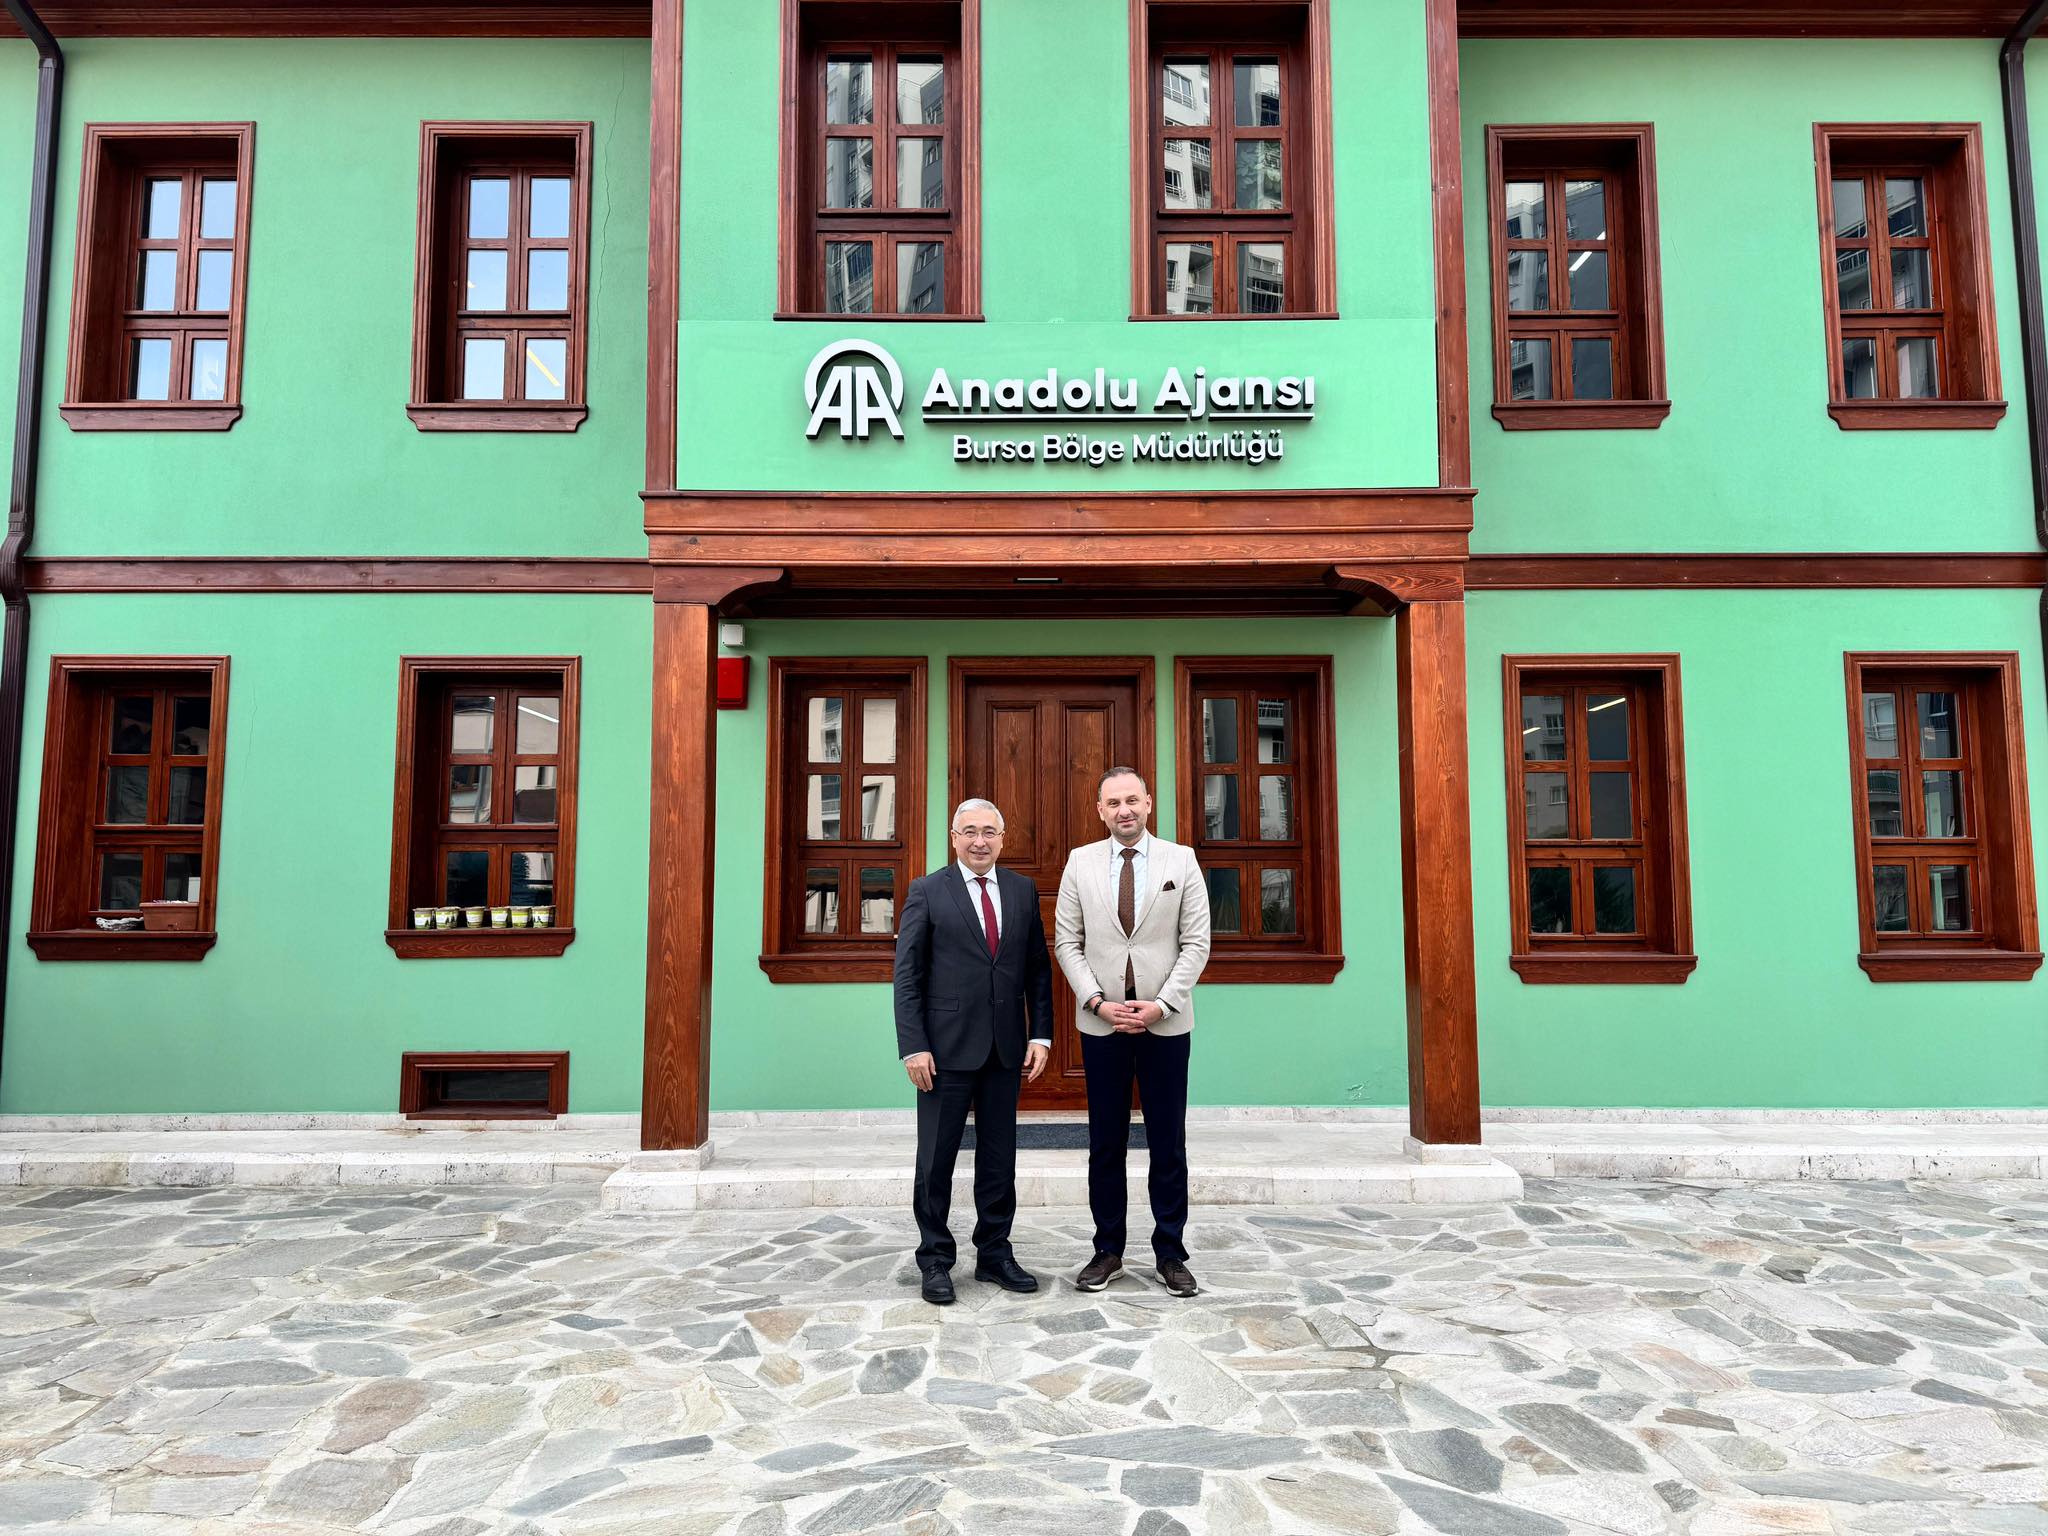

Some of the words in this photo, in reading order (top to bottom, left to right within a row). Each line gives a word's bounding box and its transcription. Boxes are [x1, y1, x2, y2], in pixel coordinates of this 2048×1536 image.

[804, 365, 905, 440] AA
[921, 367, 1138, 412] Anadolu
[1153, 366, 1316, 420] Ajansı
[953, 434, 1036, 463] Bursa
[1043, 431, 1125, 467] Bölge
[1132, 429, 1285, 466] Müdürlüğü
